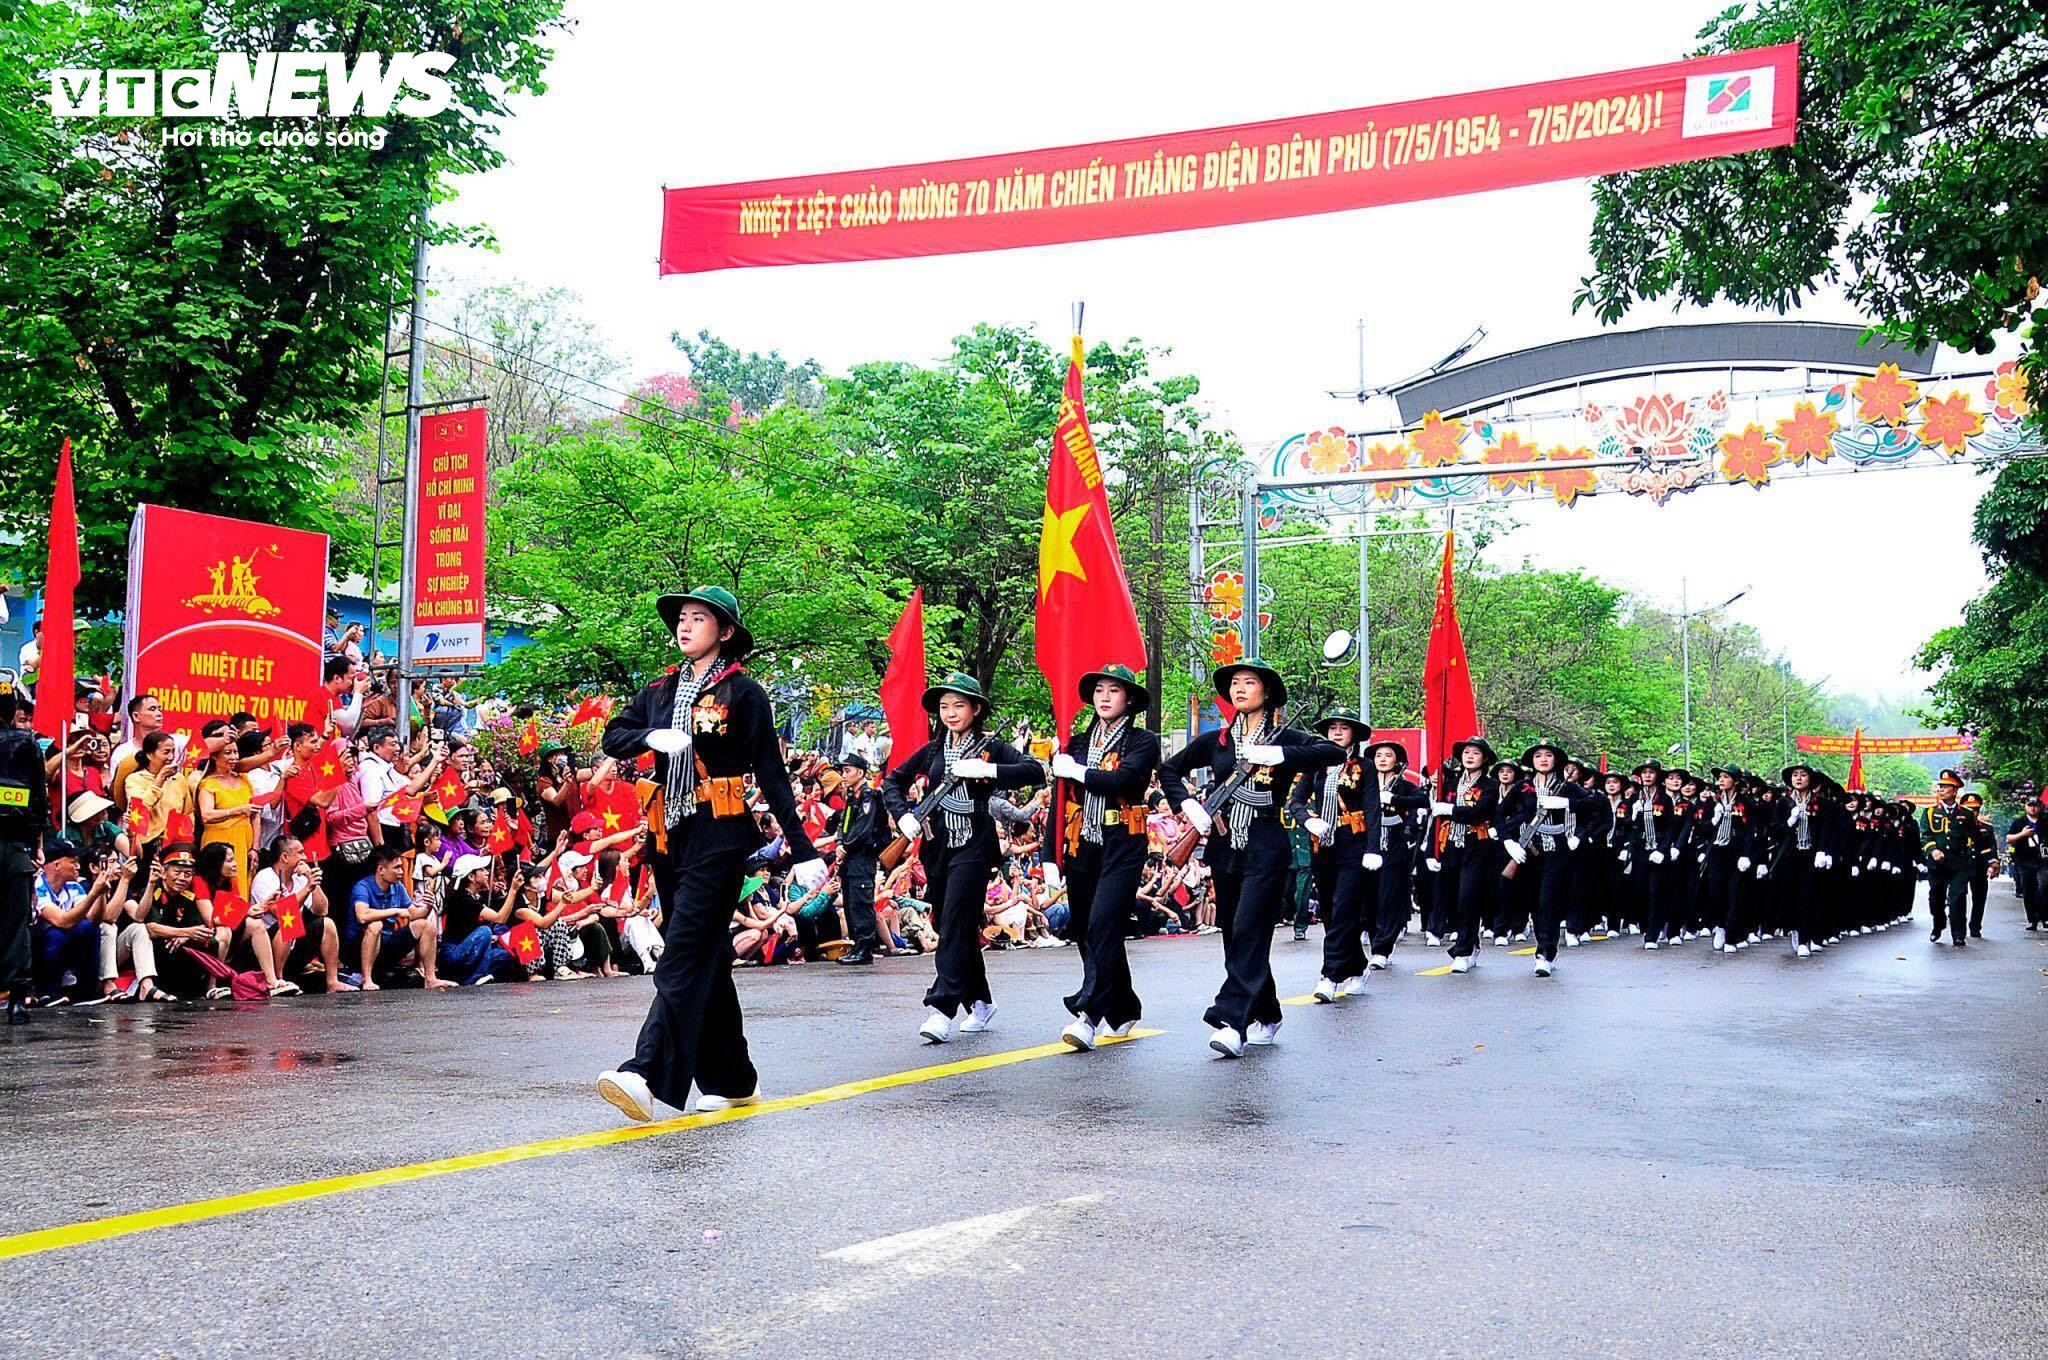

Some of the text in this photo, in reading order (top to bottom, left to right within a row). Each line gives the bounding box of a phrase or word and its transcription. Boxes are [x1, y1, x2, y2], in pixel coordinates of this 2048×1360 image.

[739, 193, 793, 238] NHIỆT
[796, 188, 836, 236] LIỆT
[839, 184, 892, 229] CHÀO
[897, 178, 959, 222] MỪNG
[964, 179, 990, 216] 70
[994, 167, 1045, 213] NĂM
[1050, 156, 1117, 208] CHIẾN
[1124, 149, 1198, 199] THẮNG
[1202, 141, 1259, 192] ĐIỆN
[1263, 132, 1322, 183] BIÊN
[1327, 120, 1377, 175] PHỦ
[1382, 114, 1501, 170] (7/5/1954
[1527, 90, 1664, 147] 7/5/2024)!
[433, 451, 469, 474] CHỦ TỊCH
[439, 476, 452, 496] CHÍ
[454, 477, 475, 494] MINH
[448, 502, 462, 522] ĐẠI
[429, 523, 469, 545] SỐNG MÃI
[435, 551, 462, 569] TRONG
[427, 571, 470, 596] SỰ NGHIỆP
[417, 597, 433, 617] CỦA
[435, 597, 463, 617] CHÚNG
[464, 599, 473, 615] TA
[441, 637, 470, 648] VNPT
[190, 651, 275, 686] NHIỆT LIỆT
[196, 688, 246, 718] MỪNG
[250, 697, 270, 719] 70
